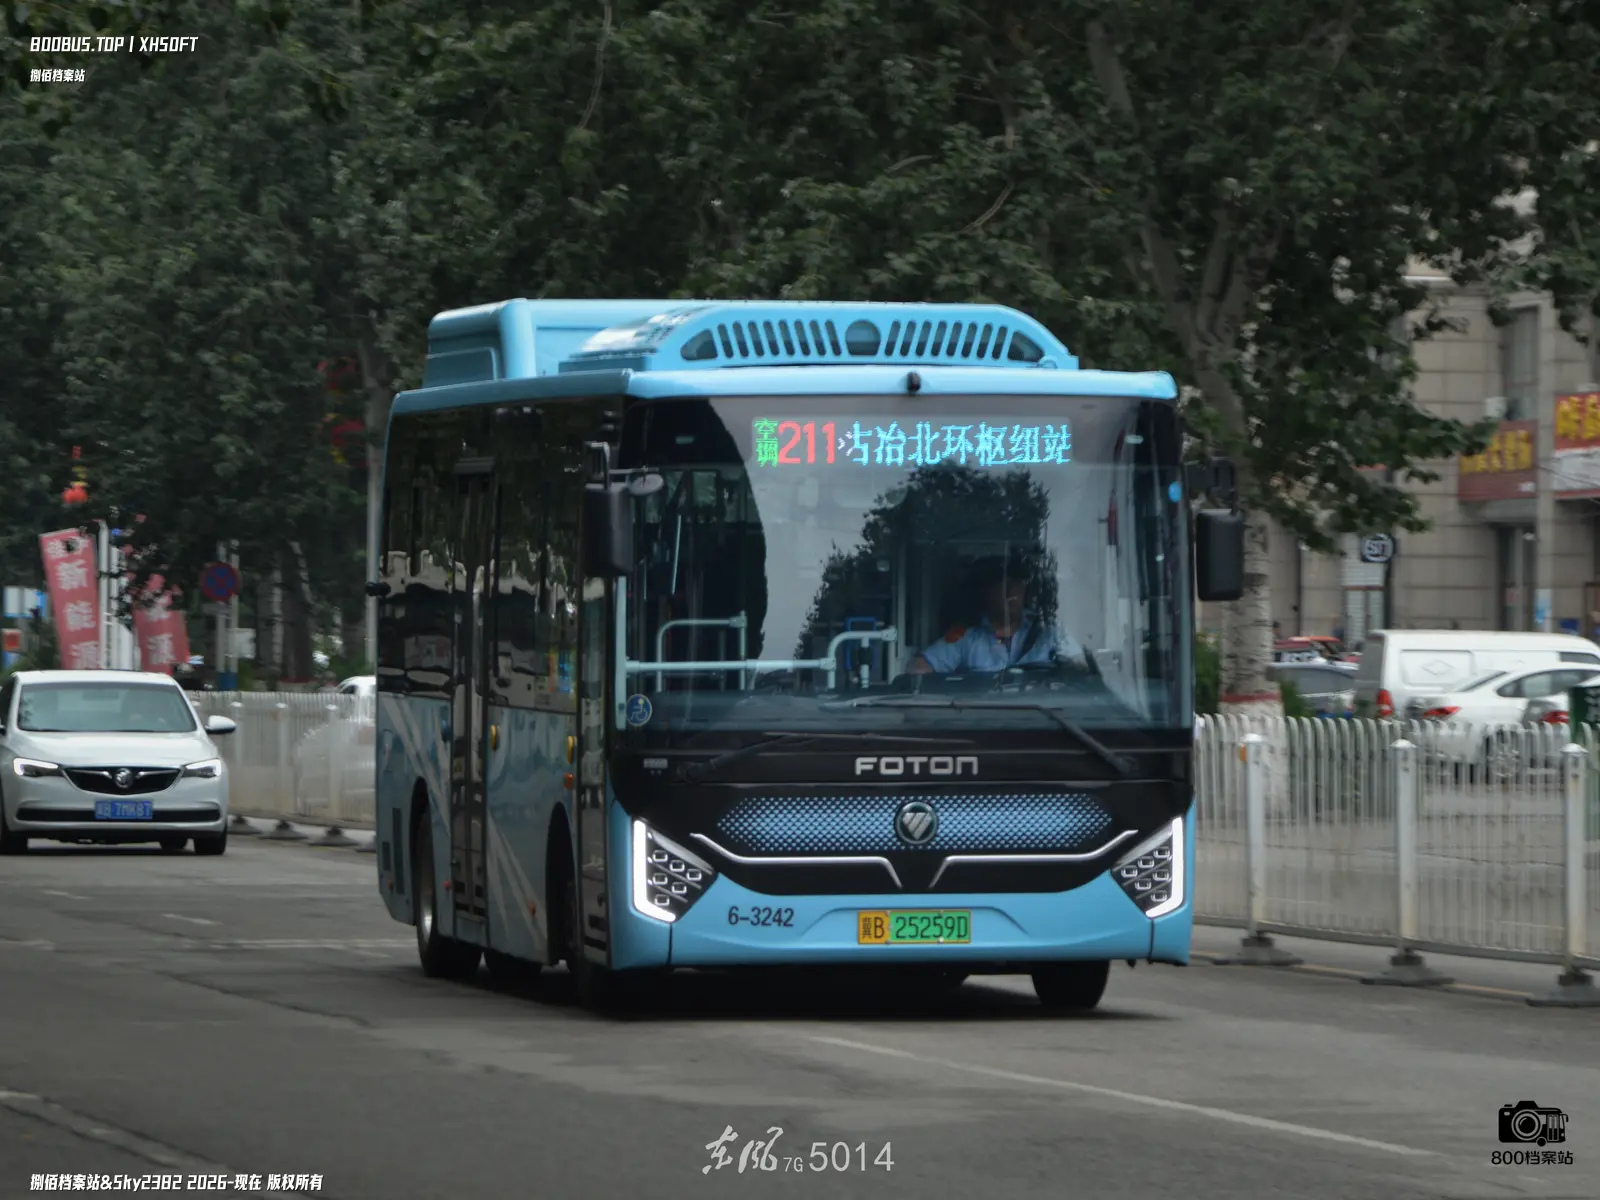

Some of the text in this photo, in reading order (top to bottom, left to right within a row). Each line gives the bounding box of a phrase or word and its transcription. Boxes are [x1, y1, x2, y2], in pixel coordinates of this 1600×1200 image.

[754, 418, 778, 468] 空调
[777, 420, 836, 464] 211
[855, 756, 979, 776] FOTON
[728, 906, 795, 928] 6-3242
[895, 915, 968, 939] 25259D
